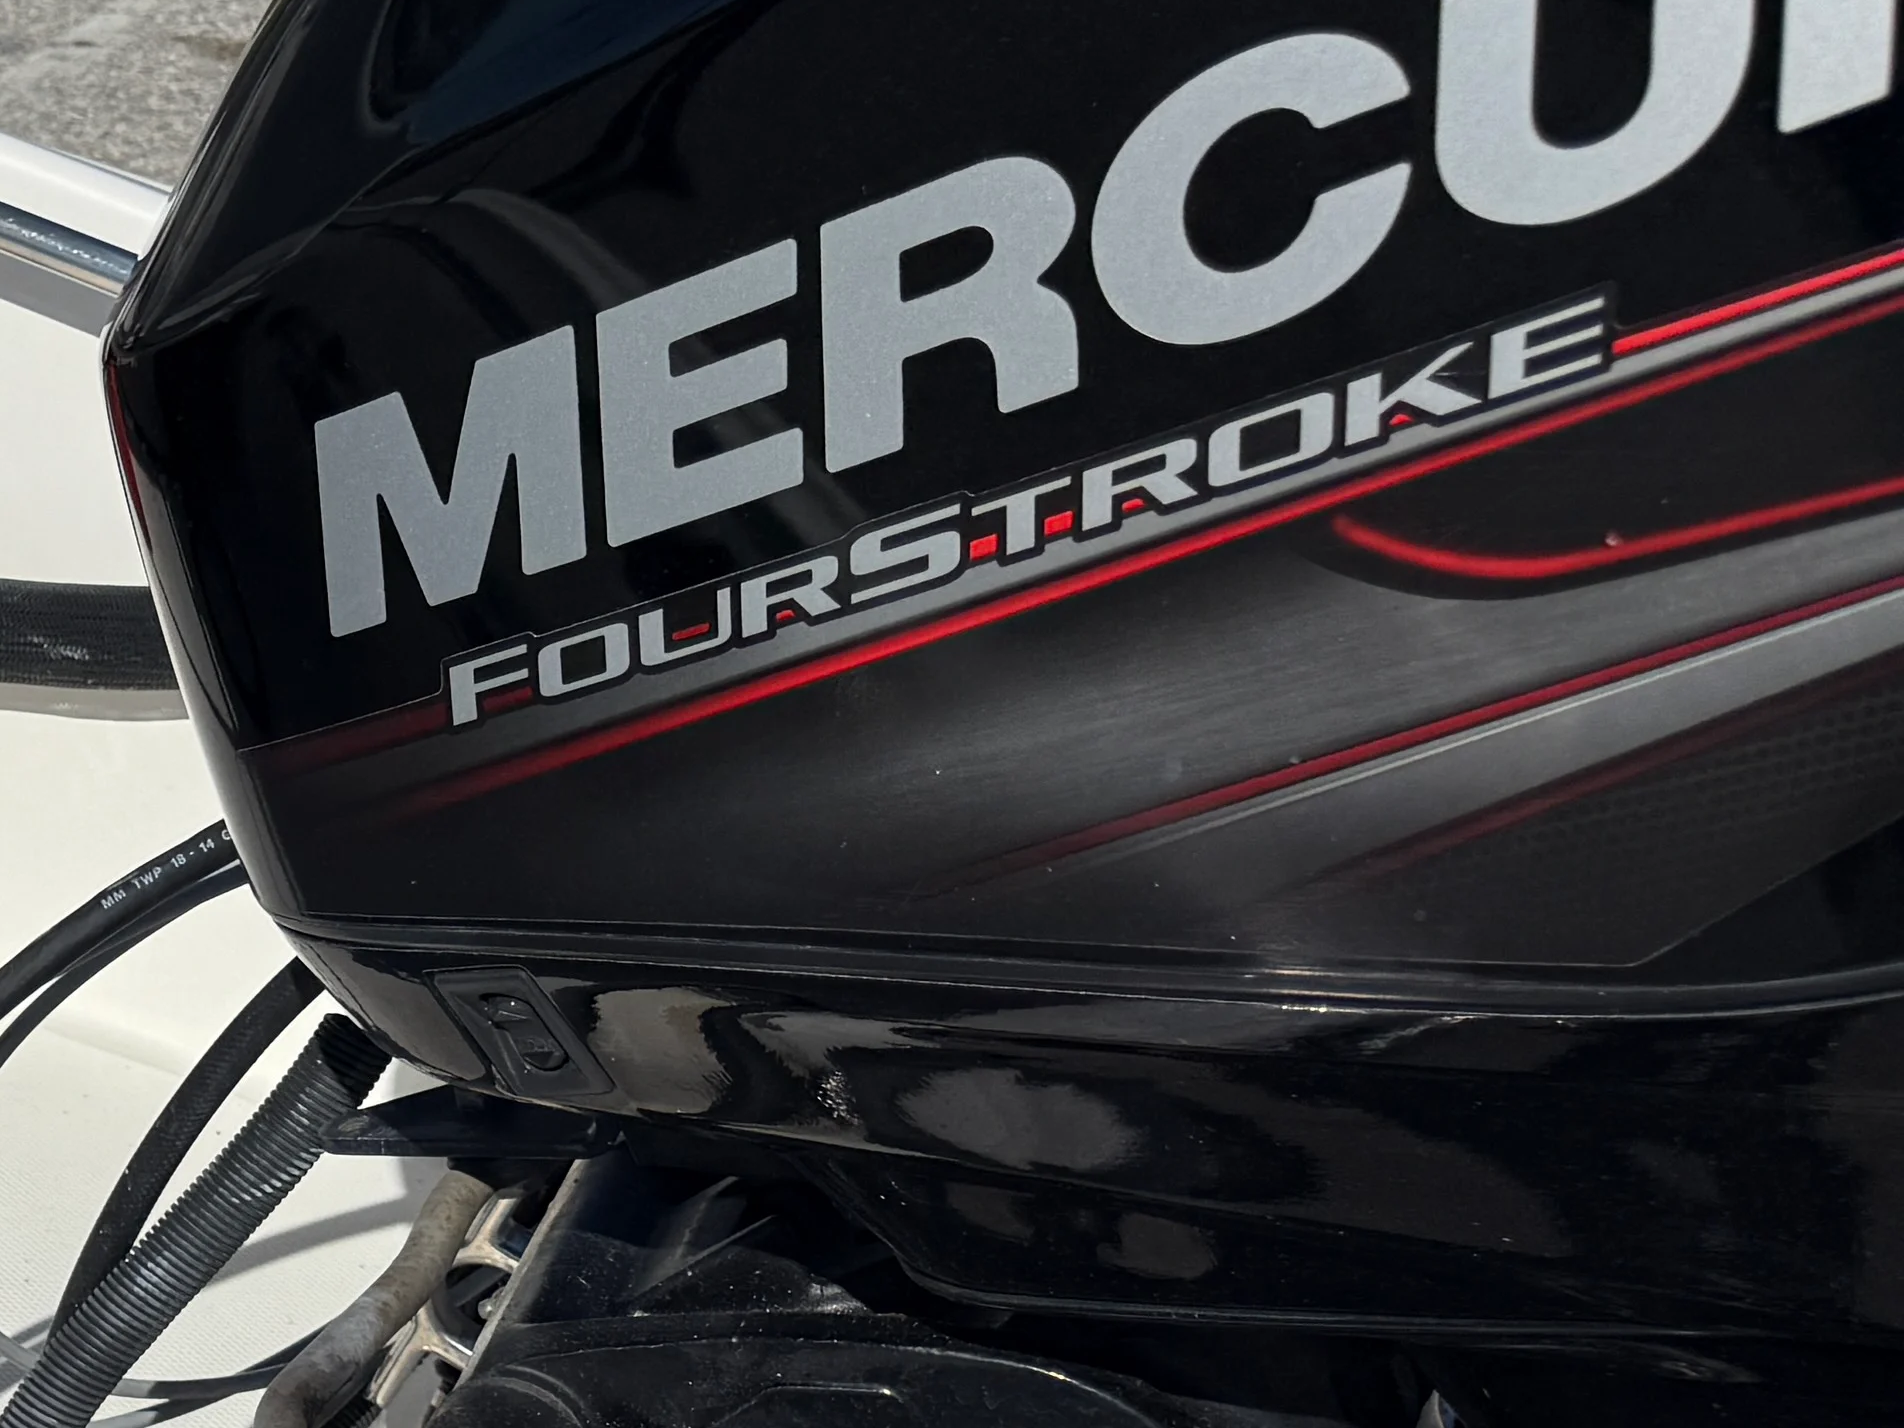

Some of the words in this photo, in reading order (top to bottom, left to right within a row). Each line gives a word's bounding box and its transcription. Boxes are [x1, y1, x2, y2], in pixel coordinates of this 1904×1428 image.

[450, 297, 1605, 725] FOURSTROKE
[100, 888, 127, 910] MM
[131, 866, 162, 889] TWP
[170, 853, 187, 868] 18
[198, 837, 215, 853] 14
